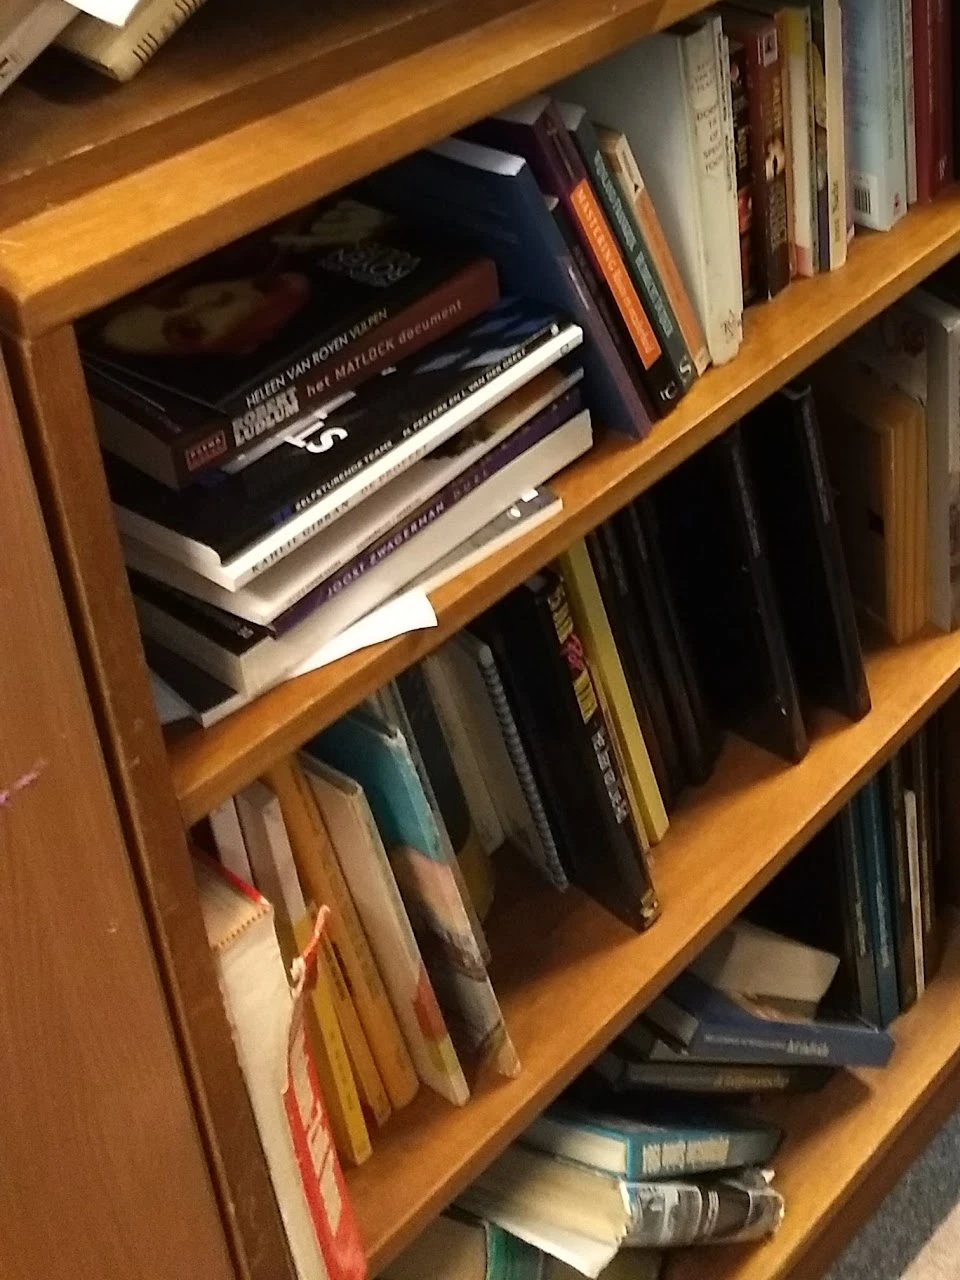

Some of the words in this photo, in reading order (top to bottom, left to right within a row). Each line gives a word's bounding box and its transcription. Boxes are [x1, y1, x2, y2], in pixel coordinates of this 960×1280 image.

[246, 374, 286, 409] HELEEN
[286, 360, 312, 384] VAN
[312, 332, 349, 367] ROYEN
[305, 377, 331, 398] het
[334, 337, 396, 384] MATLOCK
[399, 299, 463, 345] document
[327, 563, 365, 598] JOOST
[368, 501, 446, 569] ZWAGERMAN
